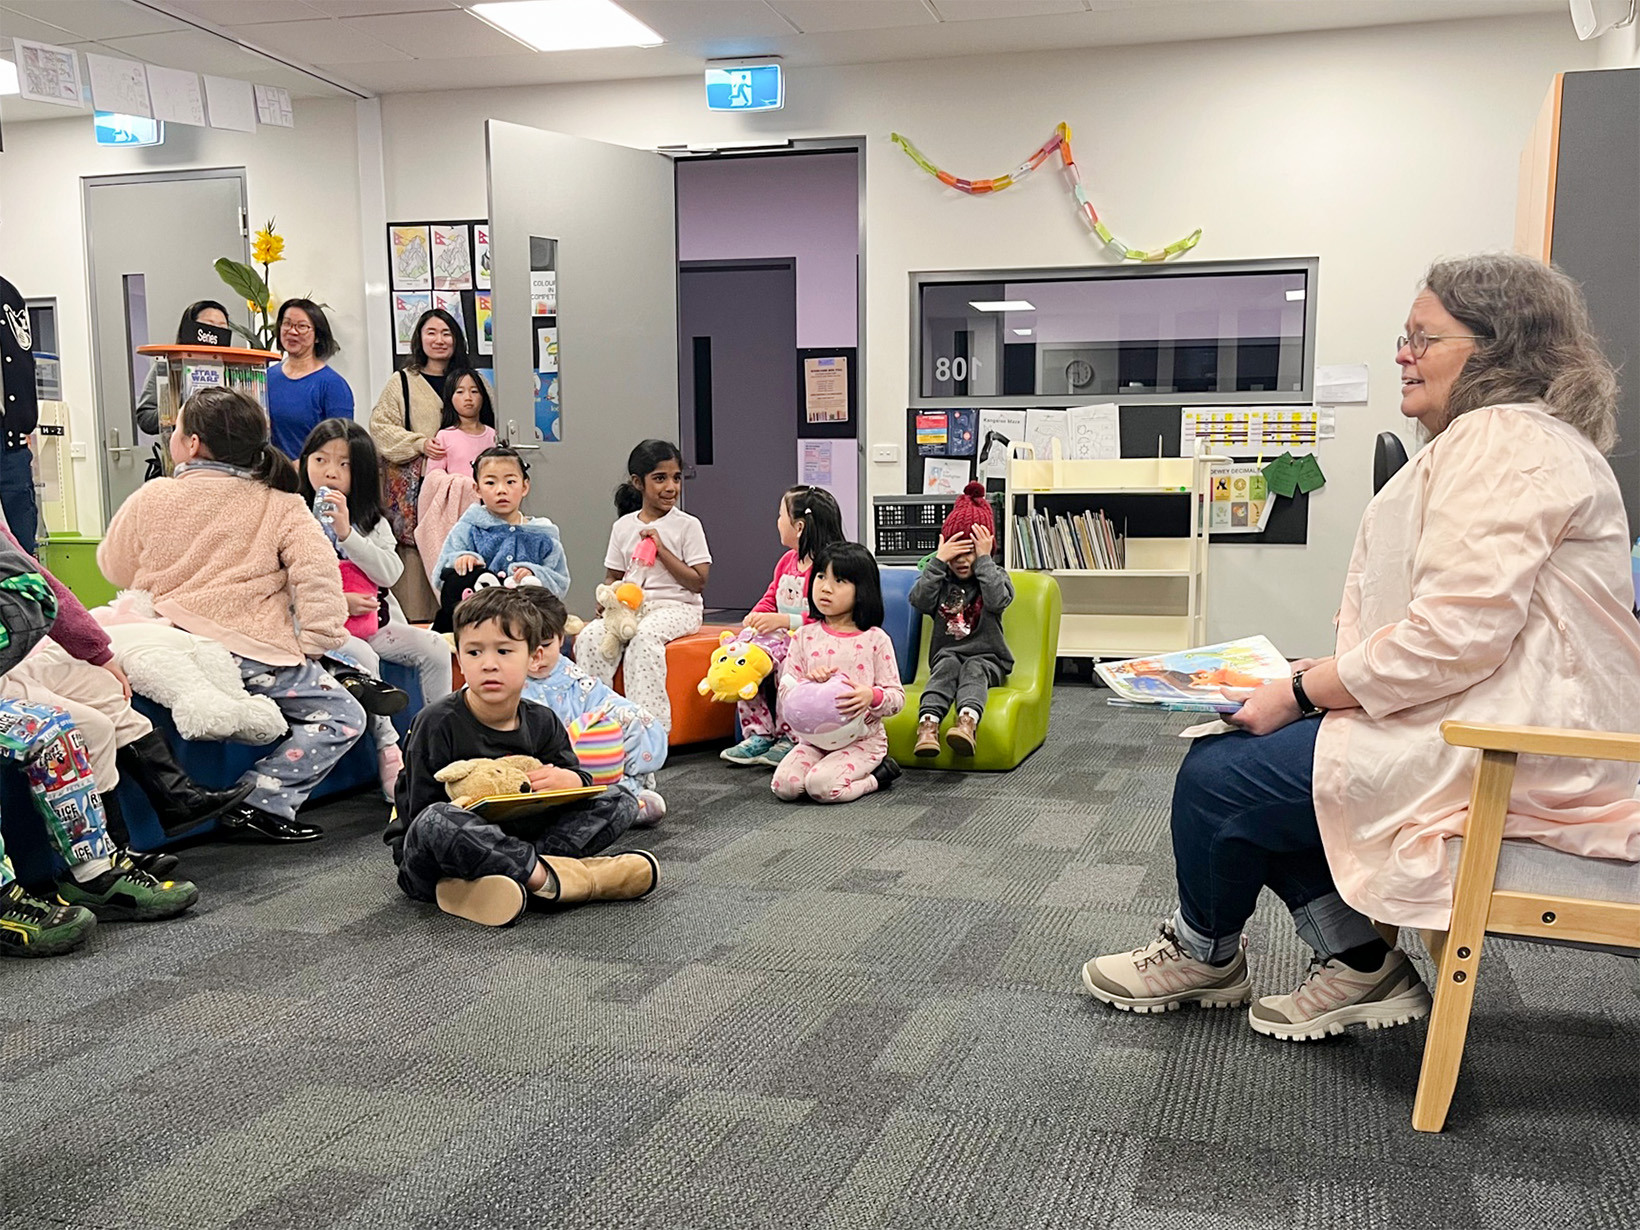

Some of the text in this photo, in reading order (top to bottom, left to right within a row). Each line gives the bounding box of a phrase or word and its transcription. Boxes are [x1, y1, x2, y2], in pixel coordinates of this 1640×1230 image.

[197, 328, 218, 345] Series
[191, 375, 220, 383] WARS
[55, 804, 77, 818] RICE
[74, 845, 90, 858] ICE
